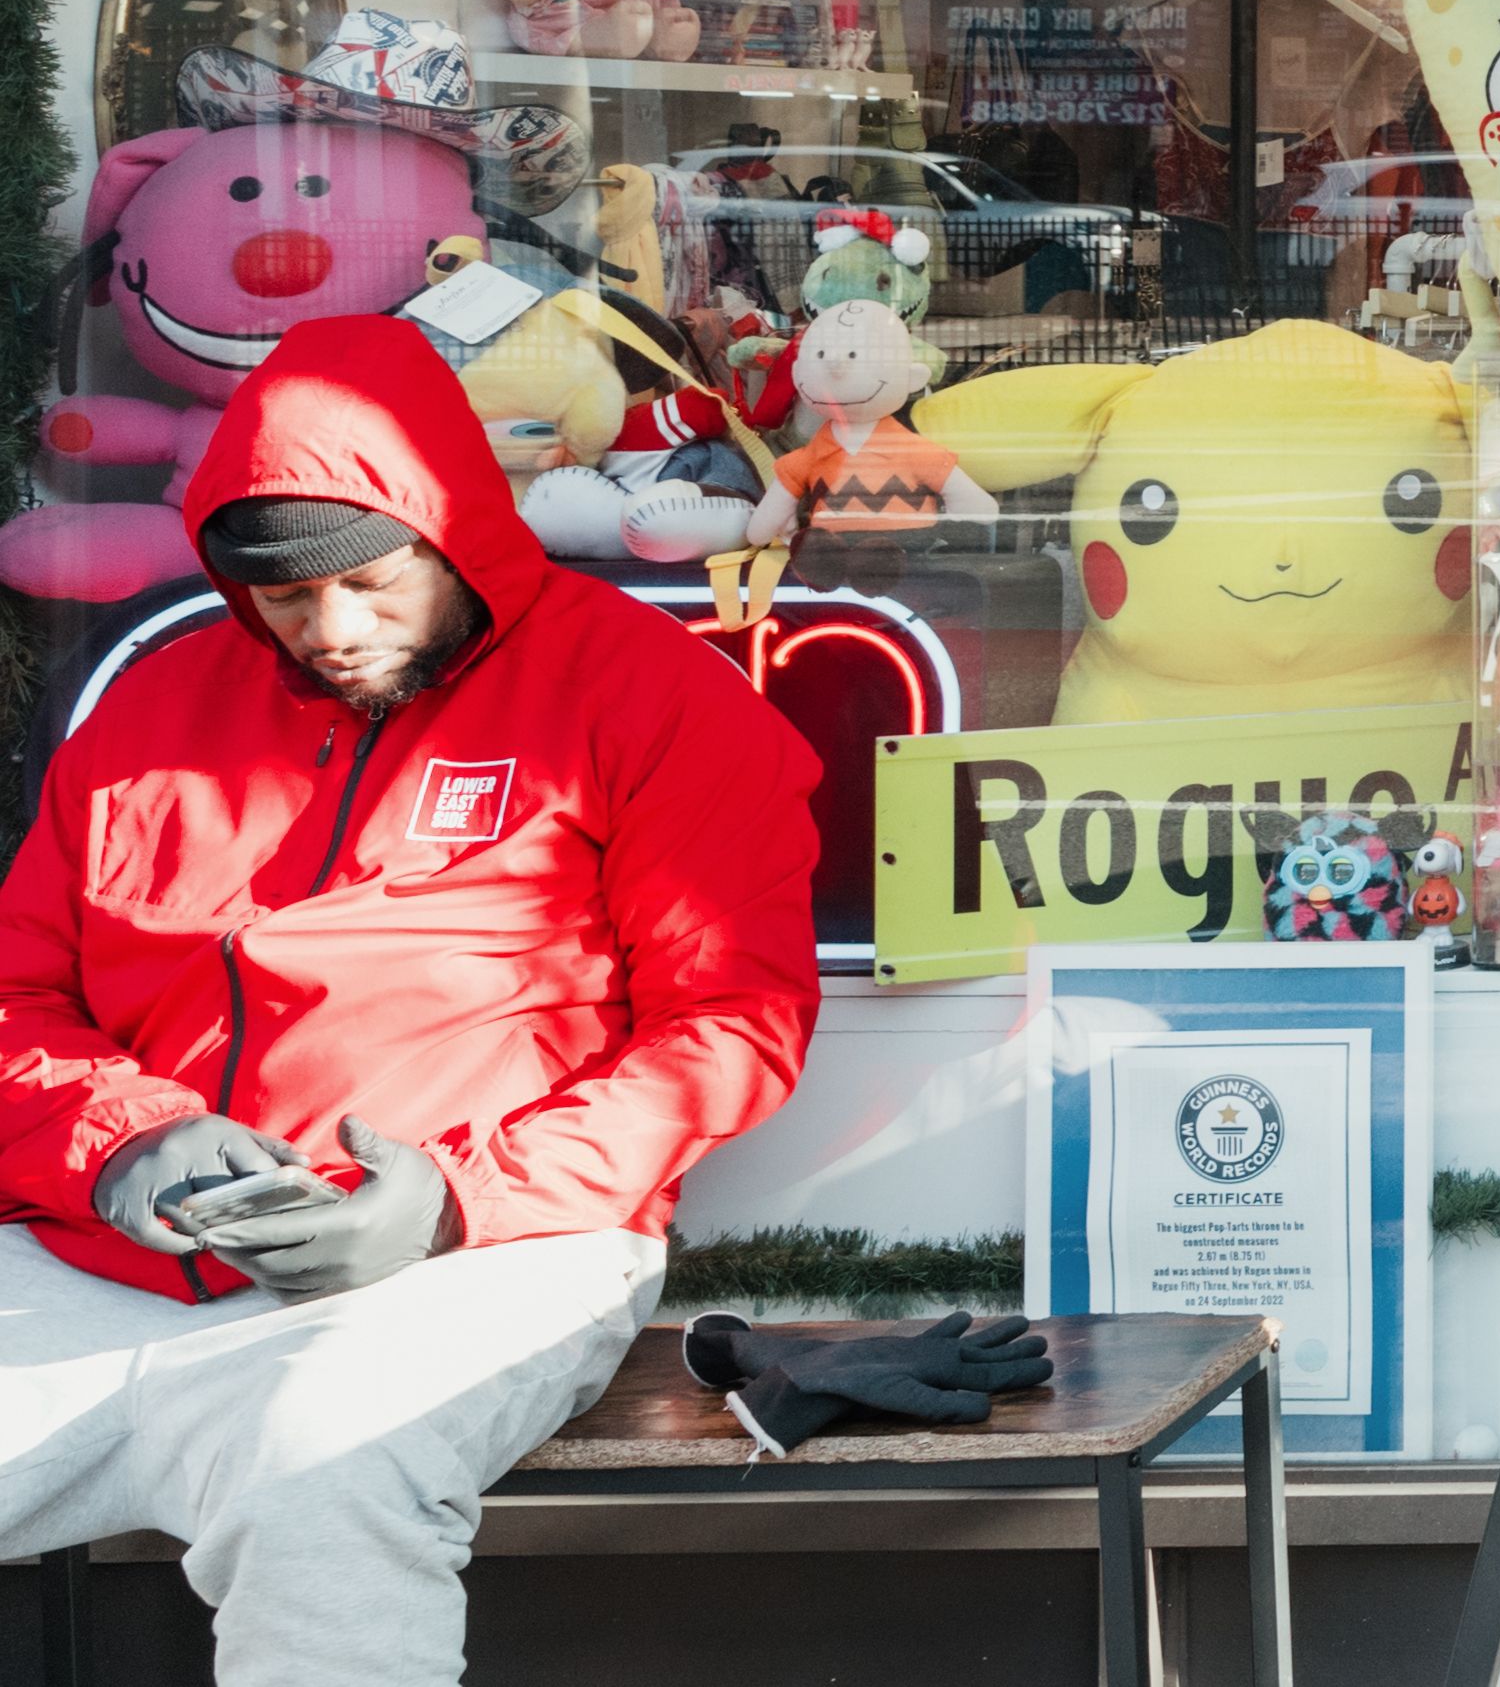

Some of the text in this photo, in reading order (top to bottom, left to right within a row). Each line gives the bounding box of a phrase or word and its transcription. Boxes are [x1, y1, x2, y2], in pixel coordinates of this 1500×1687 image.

[441, 776, 498, 793] LOWER
[435, 793, 480, 811] EAST
[430, 811, 471, 829] SIDE
[1189, 1080, 1270, 1111] GUINNESS
[1181, 1121, 1279, 1178] WORLD RECORDS
[1173, 1192, 1284, 1205] CERTIFICATE
[1156, 1222, 1172, 1233] The
[1174, 1222, 1206, 1234] biggest
[1251, 1221, 1281, 1232] throne
[1282, 1221, 1292, 1231] to
[1294, 1221, 1305, 1231] be
[1183, 1236, 1279, 1247] constructed measures
[1197, 1250, 1266, 1261] 2.67 m (8.75 ft)
[1154, 1266, 1311, 1277] and was achieved by Rogue shown in
[1152, 1281, 1178, 1293] Rogue
[1181, 1281, 1200, 1293] Fifty
[1232, 1281, 1249, 1291] New
[1185, 1295, 1284, 1307] on 24 September 2022
